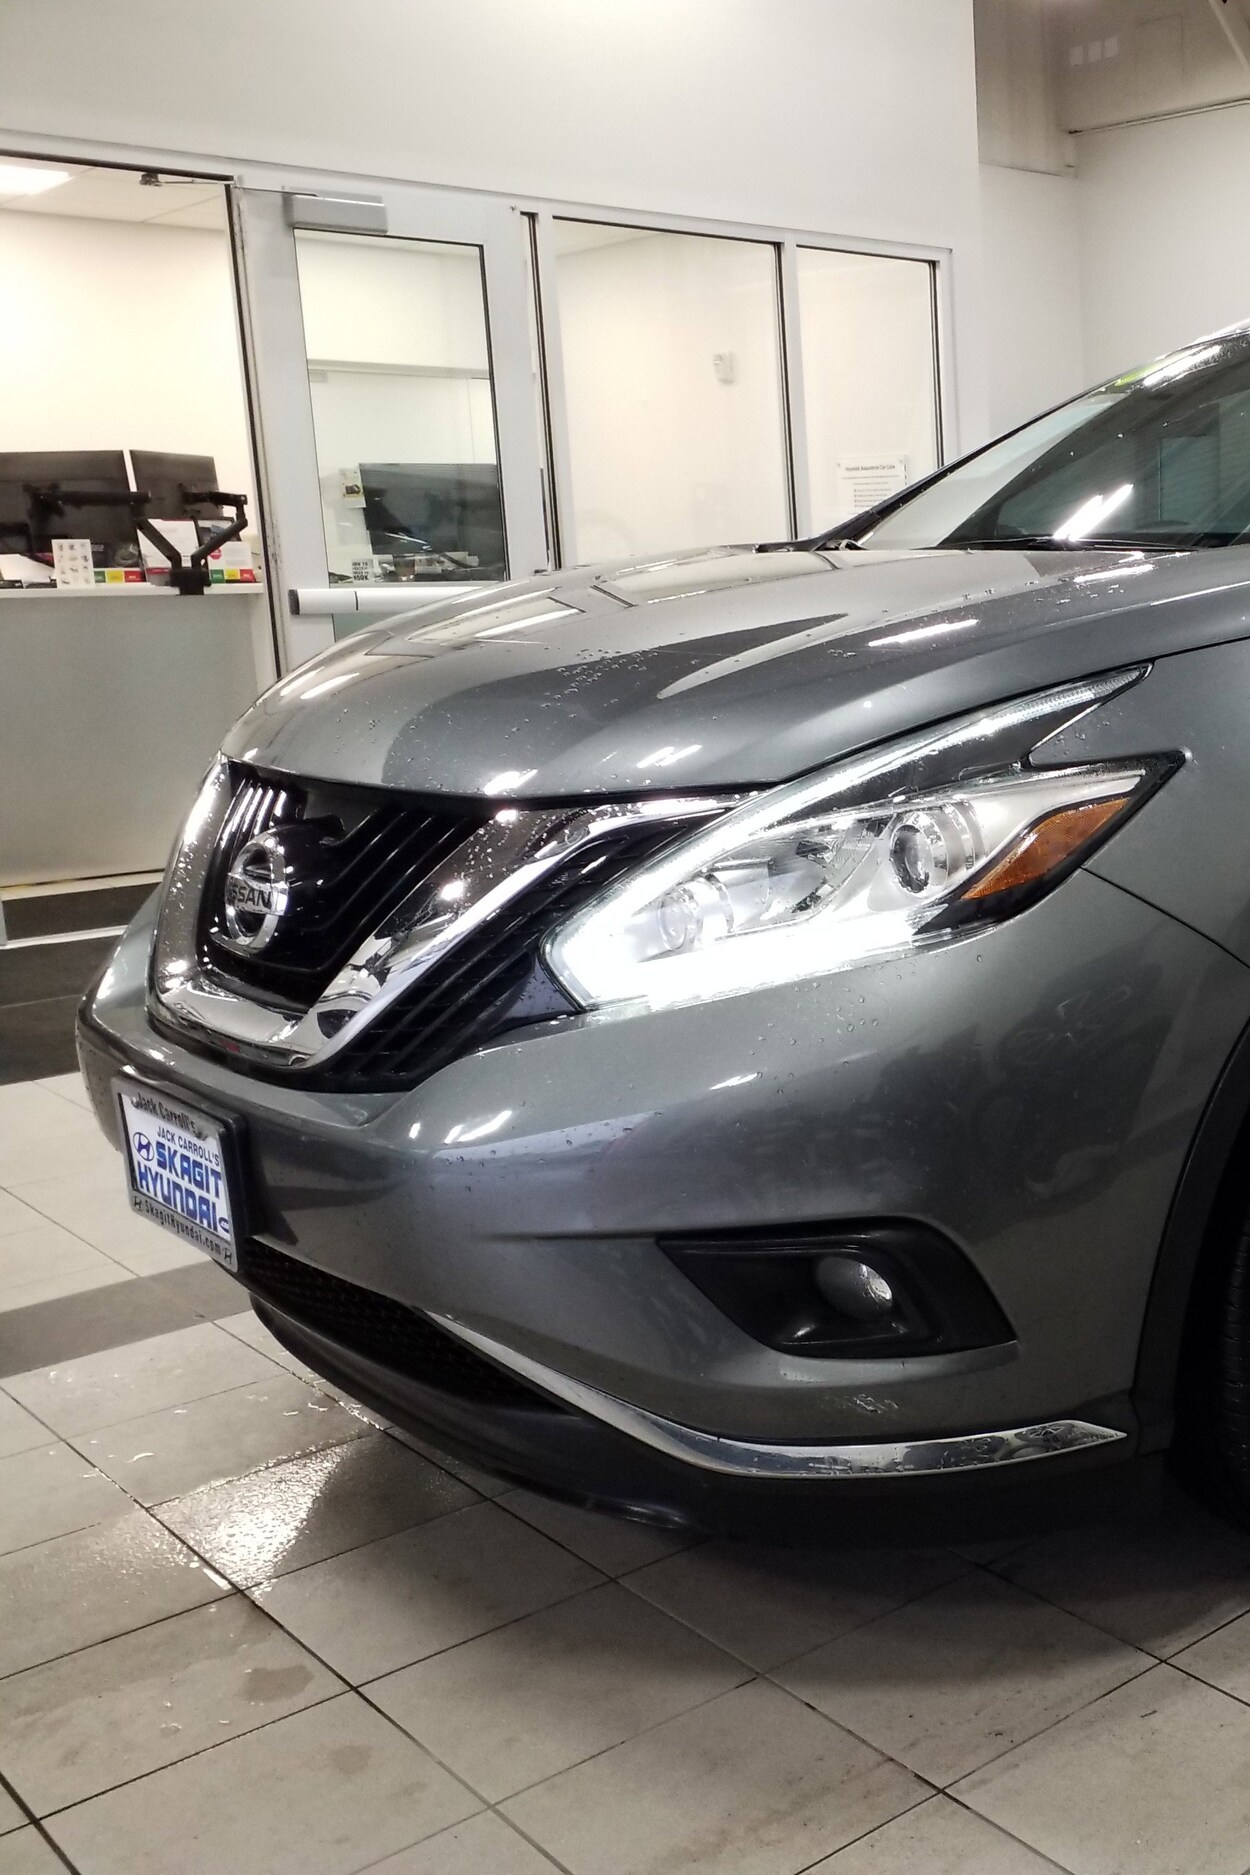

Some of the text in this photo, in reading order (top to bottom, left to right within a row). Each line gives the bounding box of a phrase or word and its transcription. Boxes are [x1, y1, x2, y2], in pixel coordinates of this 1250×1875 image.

[135, 1092, 197, 1134] Jack Carroll's
[156, 1141, 222, 1198] SKAGIT
[157, 1126, 220, 1167] JACK CARROLL'S
[138, 1161, 218, 1233] HYUNDAI
